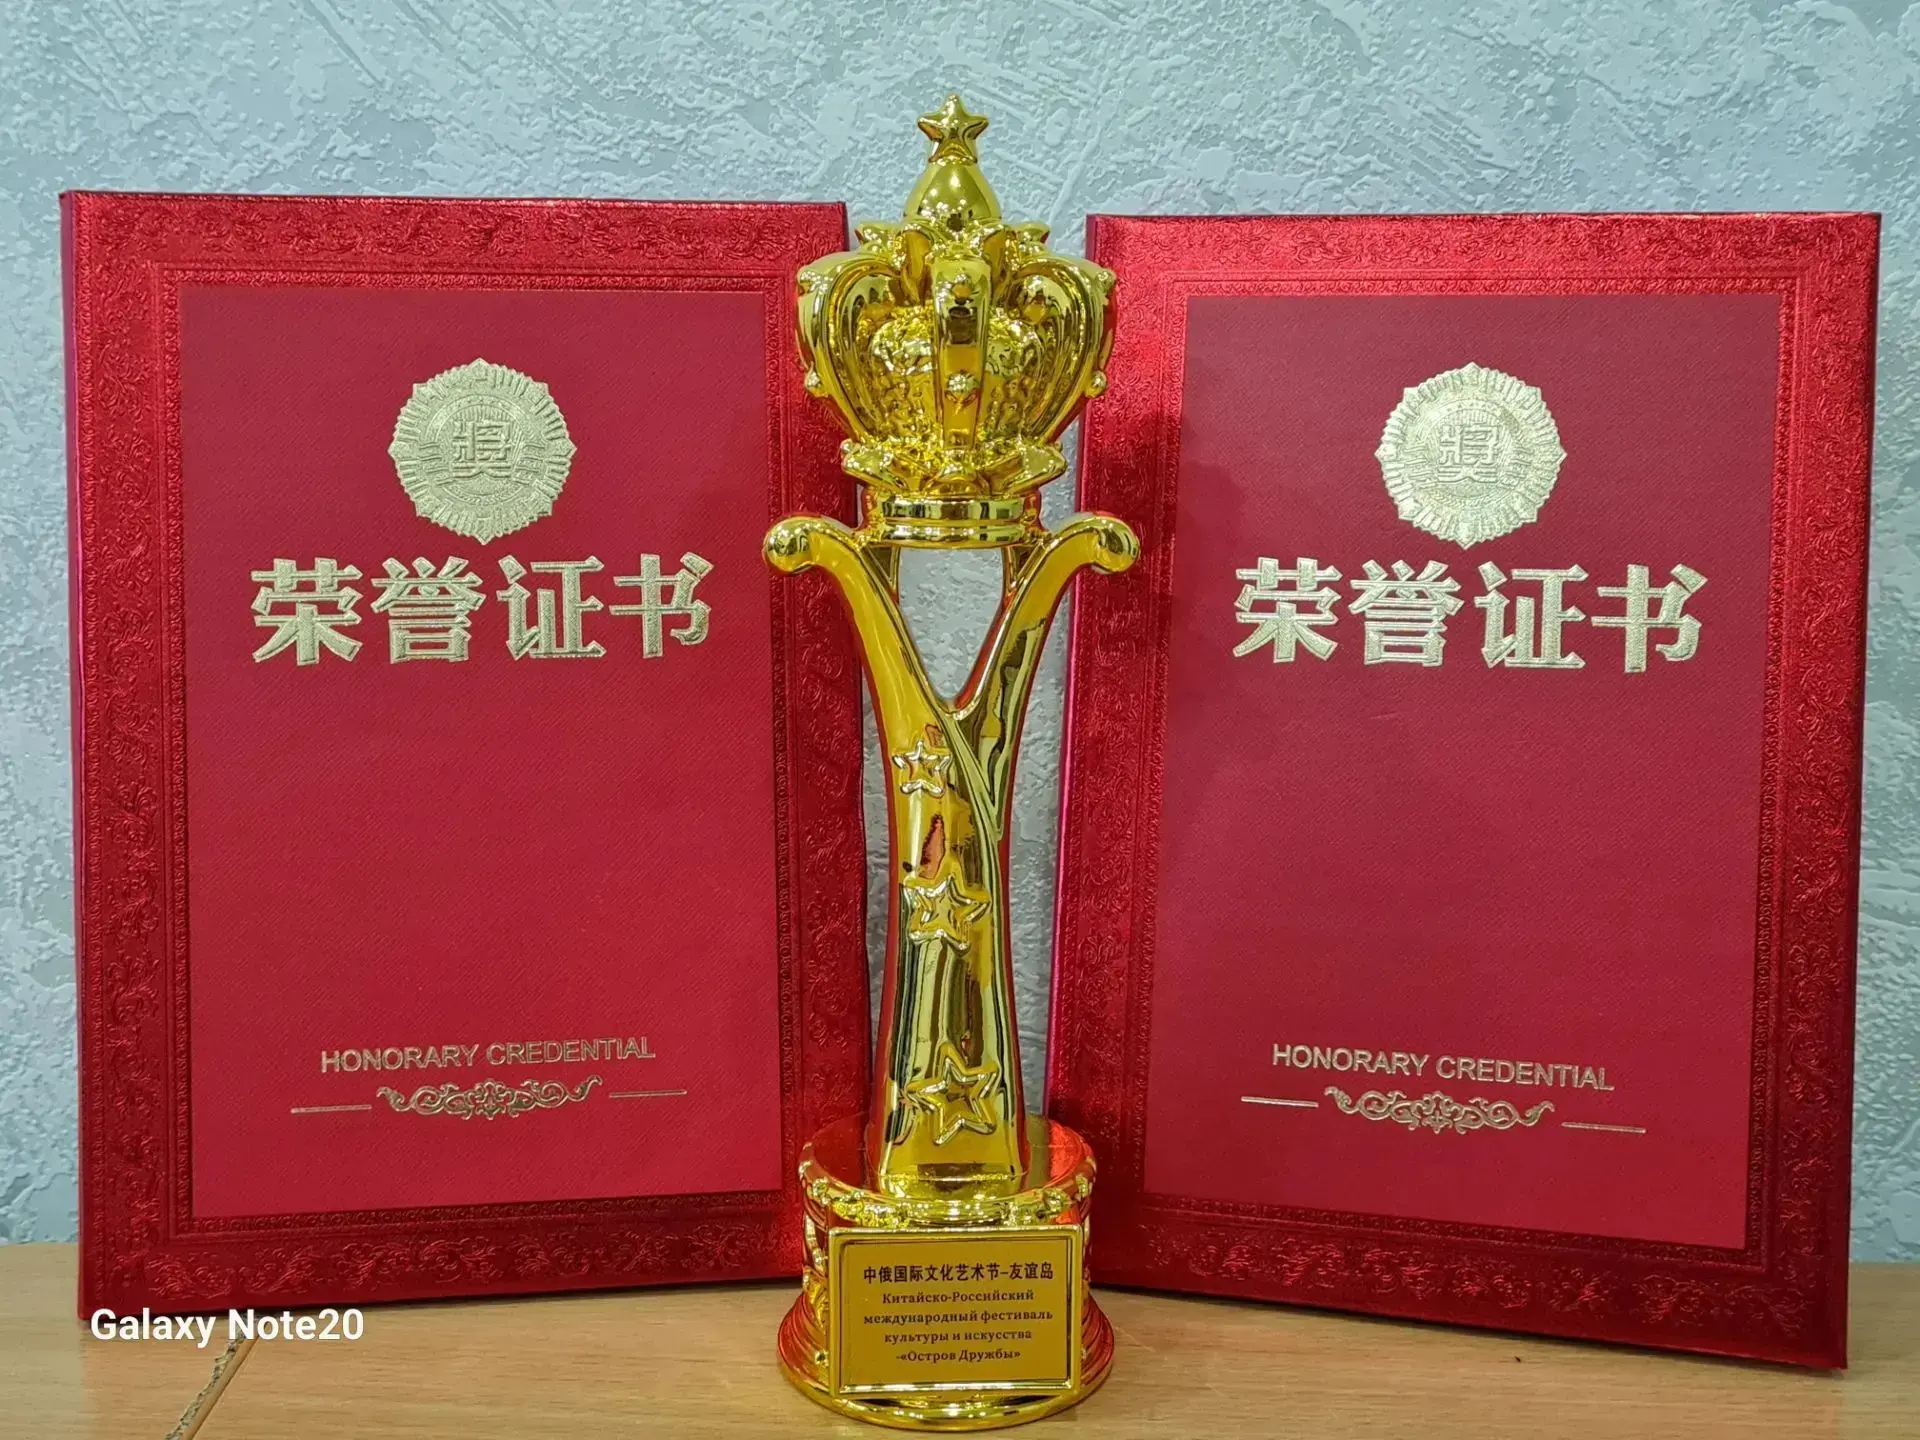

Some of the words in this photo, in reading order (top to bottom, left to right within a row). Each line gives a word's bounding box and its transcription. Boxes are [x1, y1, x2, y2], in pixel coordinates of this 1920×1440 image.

[250, 552, 714, 666] 荣誉证书
[1232, 556, 1708, 674] 荣誉证书
[319, 1043, 480, 1074] HONORARY
[485, 1036, 657, 1066] CREDENTIAL
[1272, 1043, 1431, 1077] HONORARY
[1435, 1055, 1616, 1092] CREDENTIAL
[882, 1288, 1035, 1305] Китайско-Российский
[863, 1310, 978, 1326] международный
[980, 1309, 1054, 1324] фестиваль
[884, 1331, 949, 1345] культуры
[952, 1332, 961, 1342] и
[964, 1329, 1033, 1343] искусства
